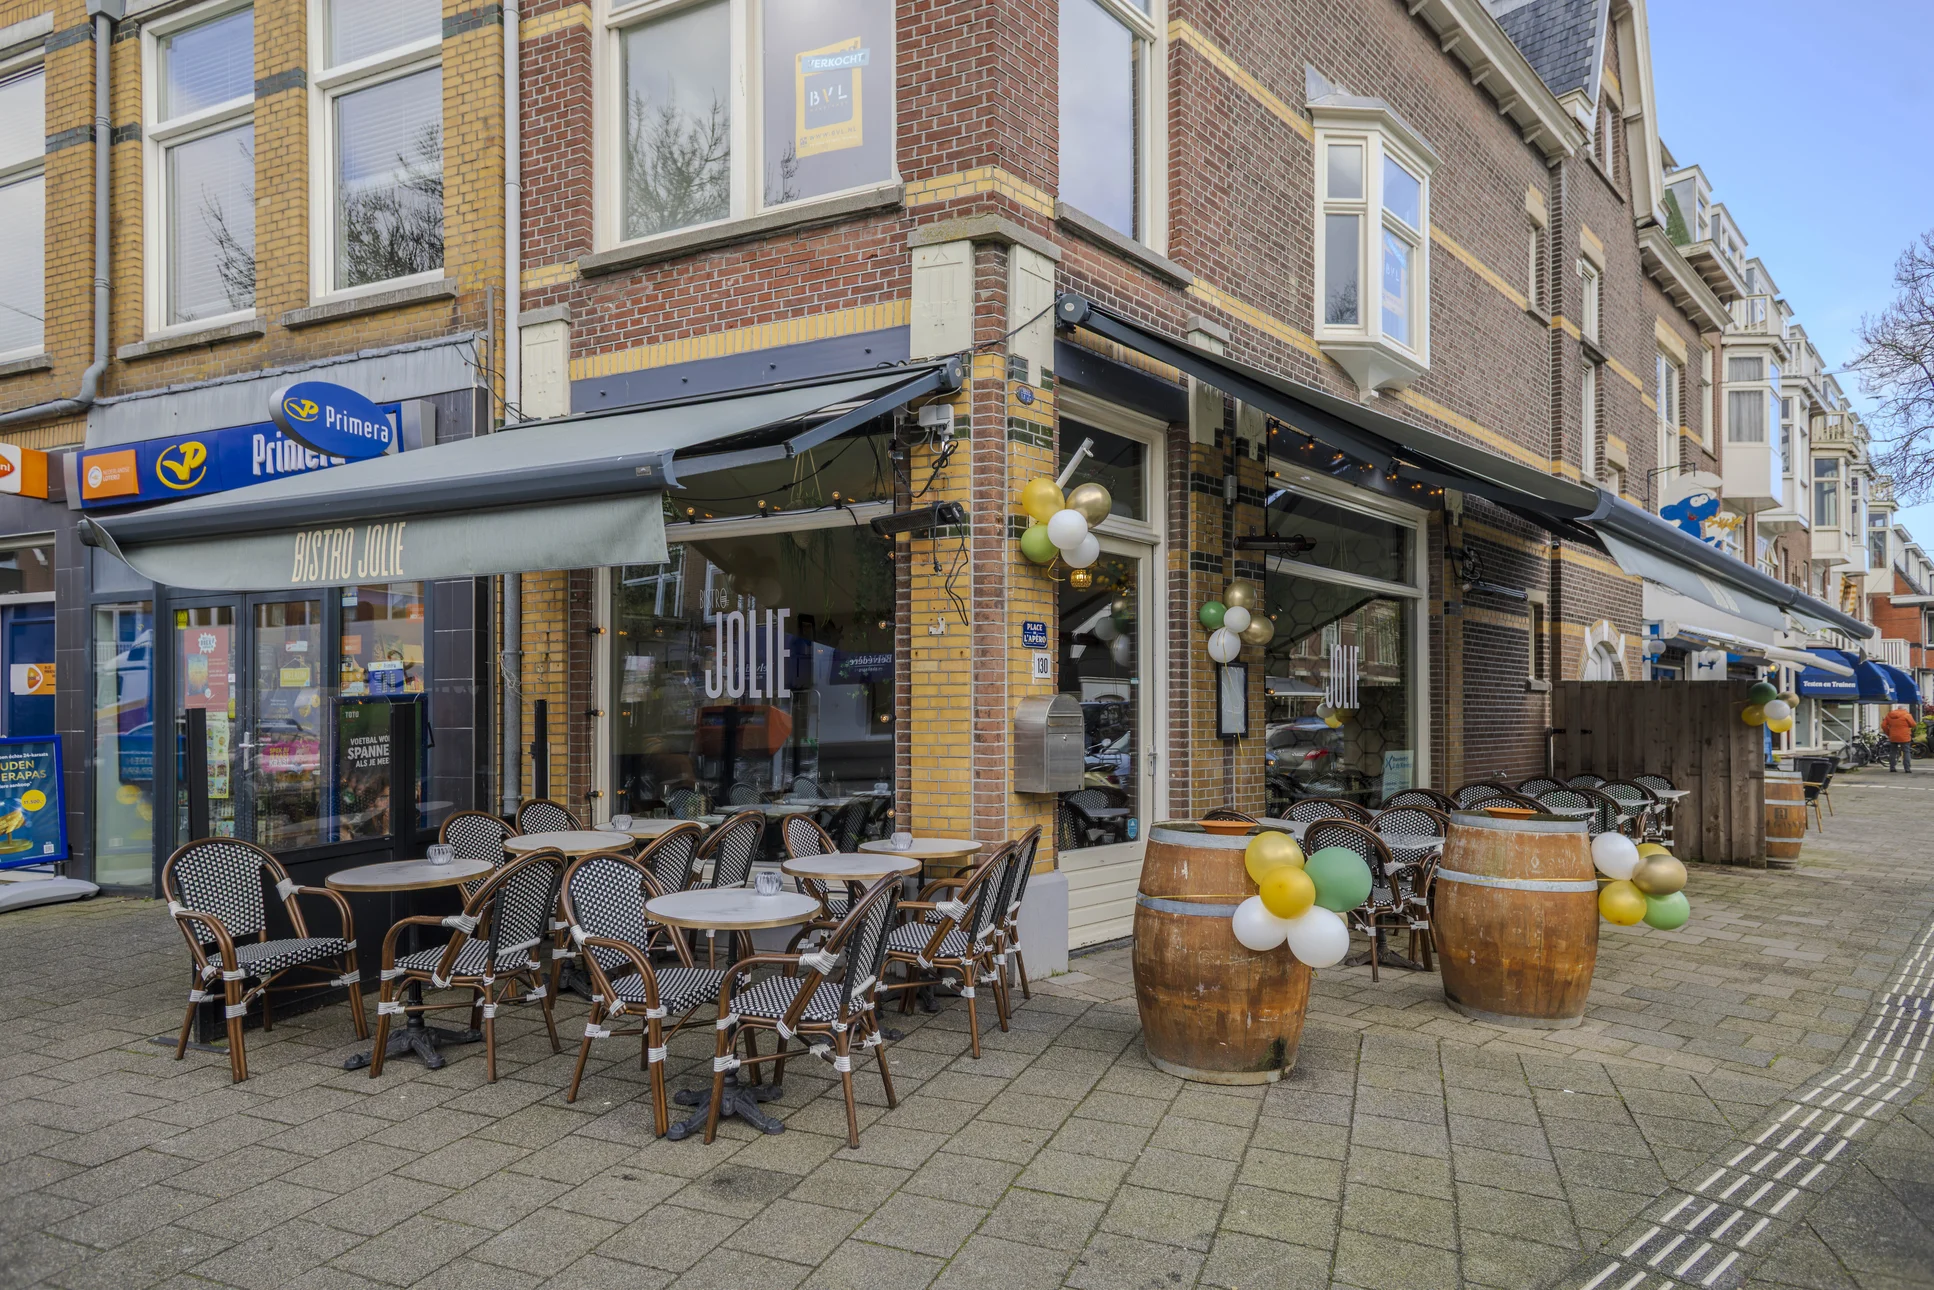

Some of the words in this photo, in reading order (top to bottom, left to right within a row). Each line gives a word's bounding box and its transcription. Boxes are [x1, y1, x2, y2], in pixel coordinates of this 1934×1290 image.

[807, 52, 864, 69] VERKOCHT
[809, 84, 848, 107] BVL
[325, 404, 389, 443] Primera
[252, 430, 346, 476] Prime
[291, 527, 355, 583] BISTRO
[357, 521, 407, 578] JOLIE
[699, 587, 730, 610] BISTRO
[1026, 623, 1043, 631] PLACE
[705, 608, 790, 698] JOLIE
[1037, 657, 1049, 674] 130
[1326, 643, 1360, 709] JOLIE
[1803, 680, 1823, 688] Testen
[345, 710, 360, 719] TOTO
[349, 736, 378, 746] VOETBAL
[347, 743, 390, 761] SPANNE
[0, 760, 35, 771] UDEN
[355, 760, 368, 768] ALS
[368, 758, 376, 767] JE
[0, 769, 47, 782] ERAPAS
